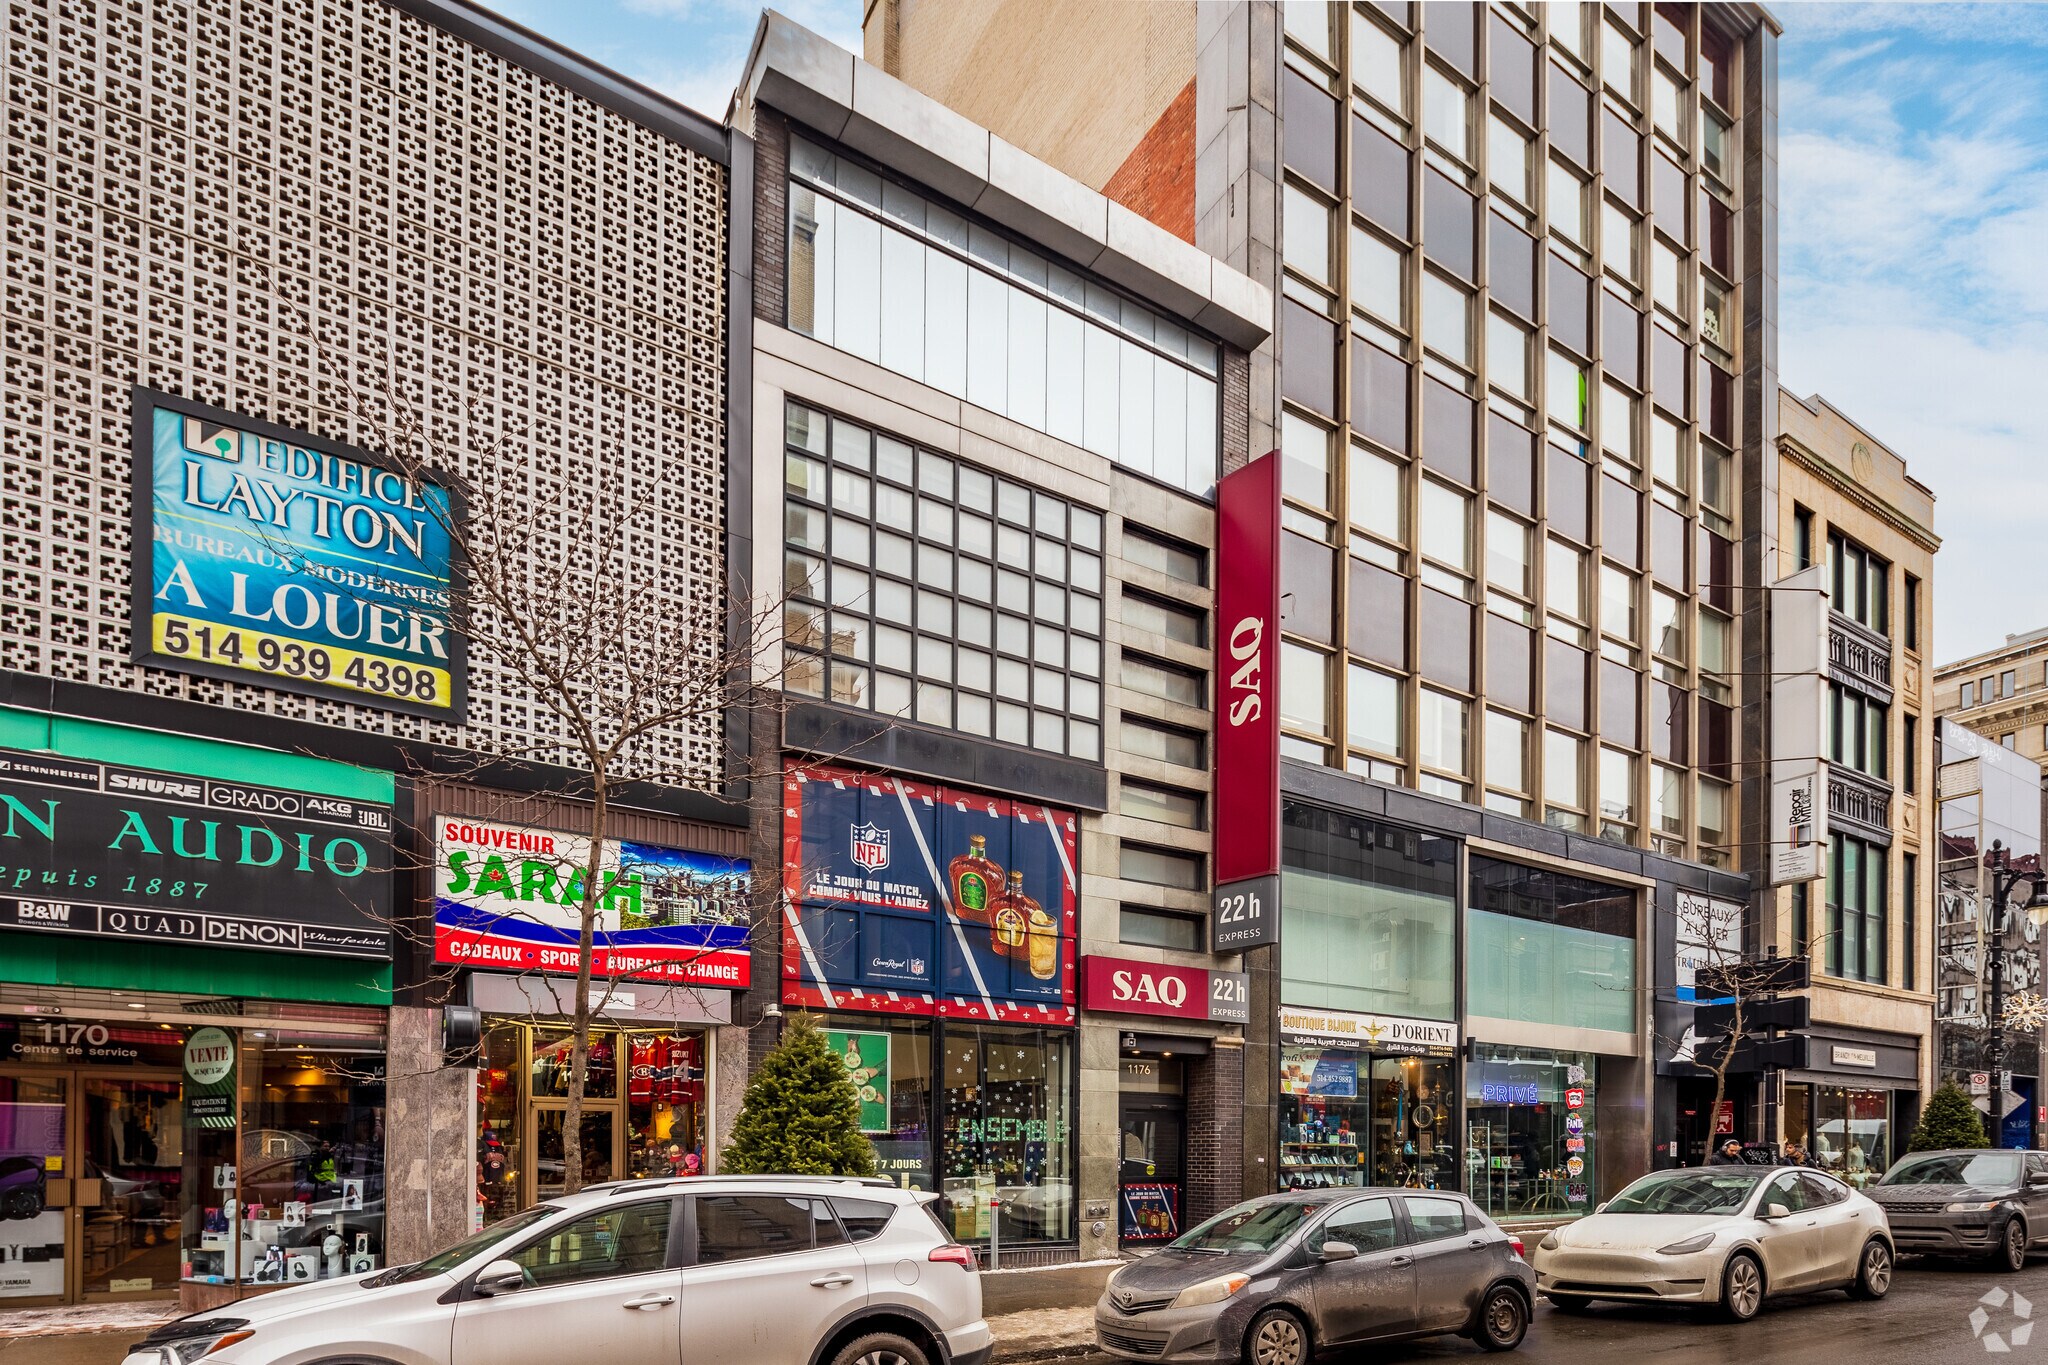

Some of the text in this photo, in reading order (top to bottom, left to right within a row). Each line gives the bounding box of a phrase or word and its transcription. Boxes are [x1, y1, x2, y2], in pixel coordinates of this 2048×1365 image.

[257, 436, 426, 512] EDIFICE
[184, 460, 425, 560] LAYTON
[152, 525, 450, 608] BUREAUX MODERNES
[155, 558, 449, 660] A LOUER
[164, 619, 436, 701] 514 939 4398
[1229, 616, 1264, 727] SAQ
[13, 763, 99, 782] SENNHEISER
[109, 774, 201, 798] SHURE
[211, 787, 300, 813] GRADO
[306, 799, 352, 814] AKG
[1789, 789, 1803, 826] iRepair
[323, 810, 352, 819] HARMAN
[358, 810, 388, 828] JBL
[107, 809, 368, 877] AUDIO
[446, 823, 554, 855] SOUVENIR
[855, 843, 885, 866] NFL
[122, 875, 208, 899] 1887
[447, 850, 642, 914] SARAH
[816, 872, 830, 884] LE
[834, 875, 862, 888] JOUR
[809, 884, 929, 910] COMME VOUS L'AIMEZ
[1220, 892, 1260, 924] 22 h
[18, 901, 71, 921] B&W
[1682, 901, 1730, 922] BUREAUX
[109, 913, 196, 936] QUAD
[208, 920, 297, 944] DENON
[1219, 928, 1261, 943] EXPRESS
[303, 931, 386, 946] Wharfedale
[450, 941, 739, 980] CADEAUX SPOR BUREAU DE CHANGE
[1112, 970, 1187, 1008] SAQ
[1213, 978, 1245, 1003] 22 h
[1212, 1008, 1246, 1018] EXPRESS
[38, 1023, 109, 1045] 1170
[1283, 1014, 1452, 1043] BOUTIQUE BIJOUX D'ORIENT
[12, 1043, 138, 1057] Centre de service
[190, 1046, 228, 1063] VENTE
[561, 1070, 589, 1081] 112
[1128, 1064, 1151, 1074] 1176
[1481, 1083, 1538, 1104] PRIVÉ
[958, 1117, 1065, 1142] ENSEMBLE
[1566, 1115, 1584, 1130] FANTA
[881, 1160, 887, 1169] 7
[890, 1160, 922, 1169] JOURS
